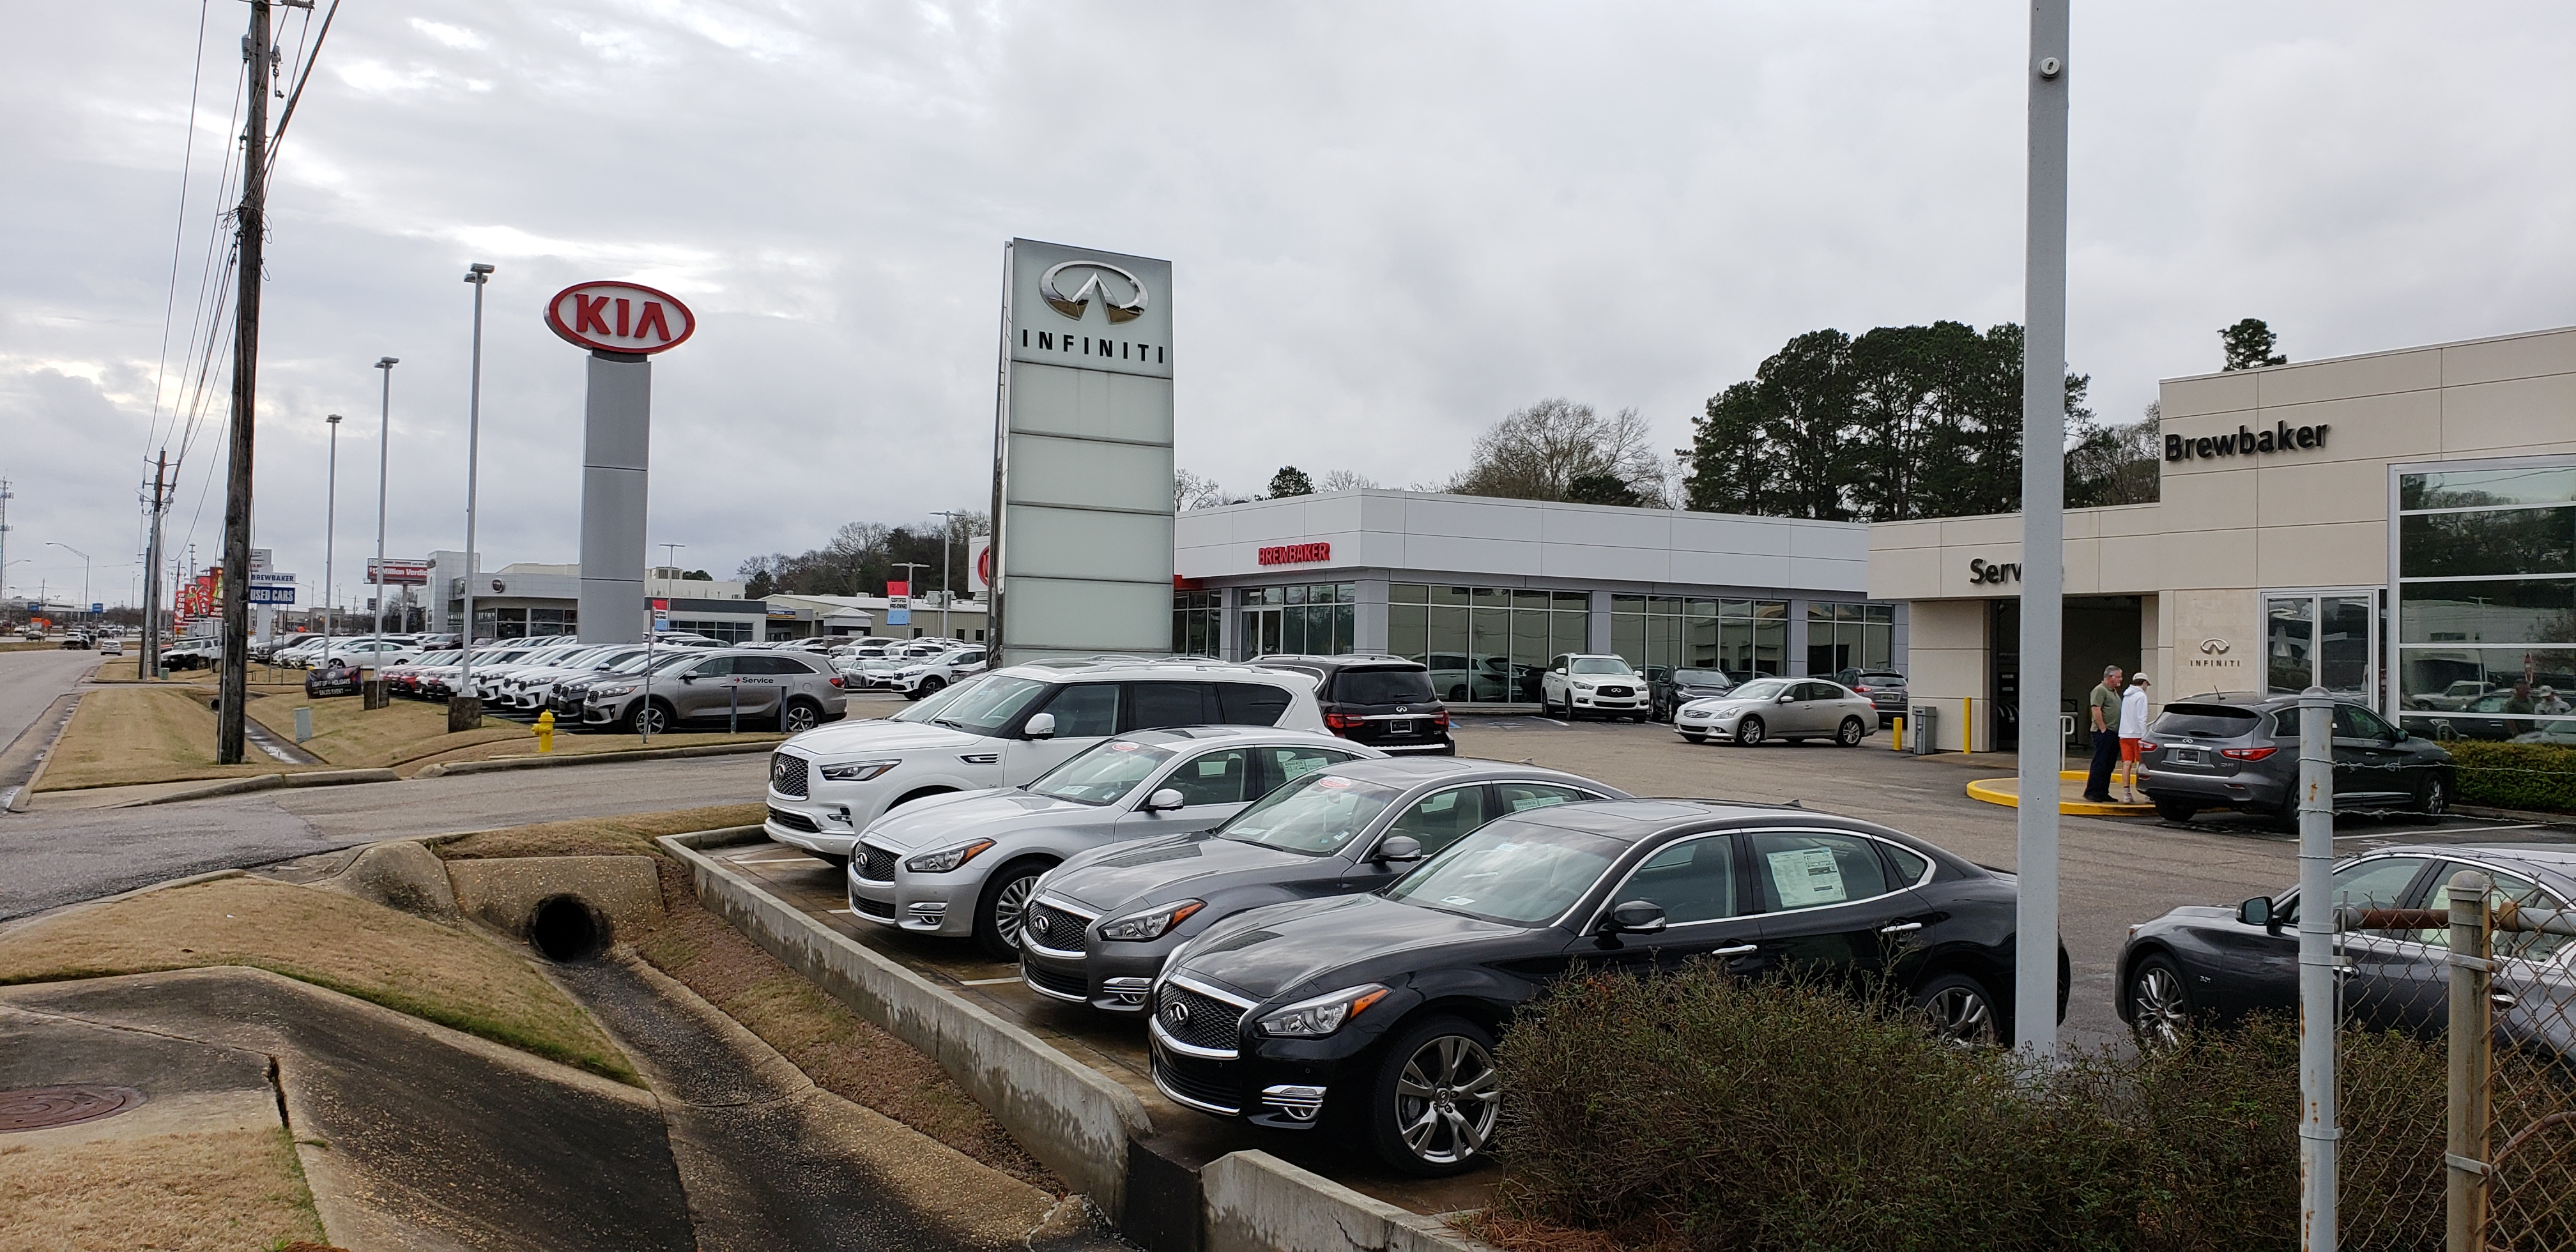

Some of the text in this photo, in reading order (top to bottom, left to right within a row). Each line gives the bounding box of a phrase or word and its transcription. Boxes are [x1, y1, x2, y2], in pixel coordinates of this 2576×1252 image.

[575, 293, 671, 341] KIA
[1023, 329, 1163, 364] INFINITI
[2165, 420, 2329, 462] Brewbaker
[1258, 542, 1330, 565] BREWBAKER
[1970, 558, 2022, 584] Serv
[250, 589, 294, 602] USED CARS
